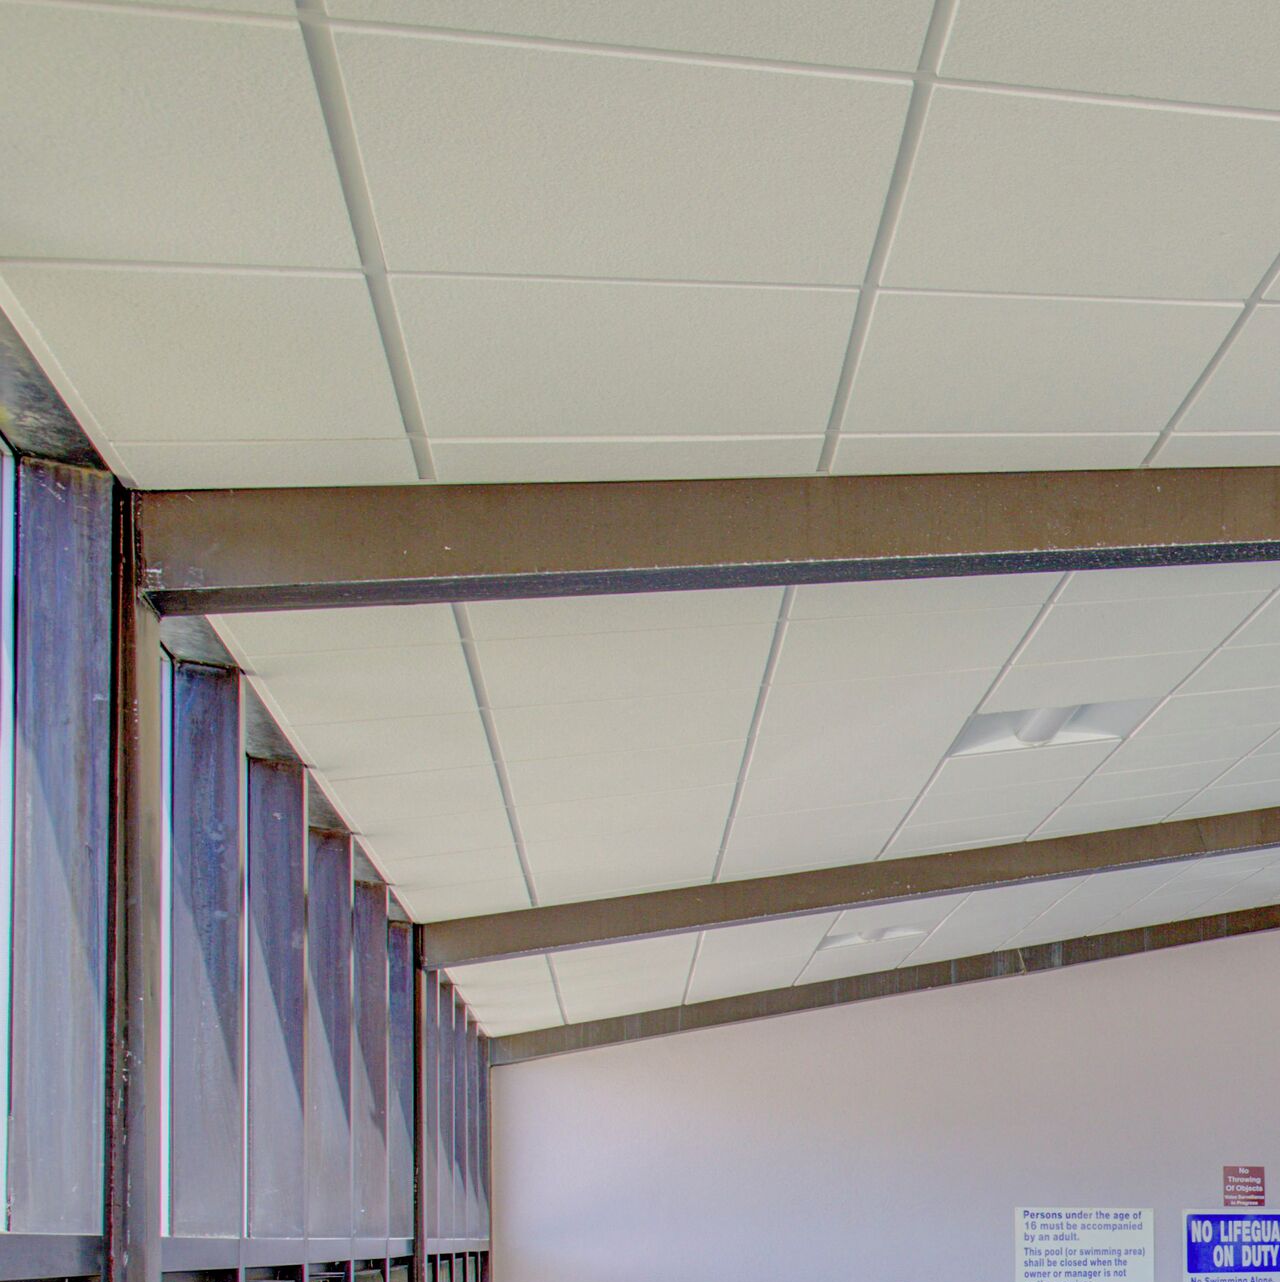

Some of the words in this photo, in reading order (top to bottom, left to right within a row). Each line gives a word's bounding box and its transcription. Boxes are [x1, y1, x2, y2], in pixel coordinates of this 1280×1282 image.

[1227, 1176, 1261, 1184] Throwing
[1235, 1185, 1263, 1193] Objects
[1023, 1210, 1062, 1219] Persons
[1065, 1211, 1092, 1219] under
[1095, 1211, 1110, 1219] the
[1113, 1212, 1129, 1221] age
[1132, 1211, 1142, 1219] of
[1025, 1222, 1037, 1230] 16
[1040, 1222, 1064, 1230] must
[1066, 1222, 1077, 1230] be
[1080, 1222, 1143, 1231] accompanied
[1191, 1220, 1213, 1243] NO
[1024, 1233, 1035, 1242] by
[1053, 1233, 1080, 1241] adult.
[1024, 1247, 1042, 1256] This
[1044, 1248, 1062, 1257] pool
[1065, 1247, 1077, 1257] (or
[1079, 1247, 1121, 1257] swimming
[1124, 1247, 1145, 1257] area)
[1213, 1244, 1234, 1267] ON
[1241, 1244, 1280, 1267] DUTY
[1024, 1259, 1044, 1267] shall
[1047, 1259, 1057, 1267] be
[1060, 1258, 1087, 1267] closed
[1090, 1258, 1112, 1267] when
[1114, 1258, 1127, 1266] the
[1024, 1270, 1051, 1278] owner
[1053, 1270, 1062, 1278] or
[1064, 1270, 1101, 1279] manager
[1103, 1269, 1111, 1277] is
[1113, 1269, 1126, 1277] not
